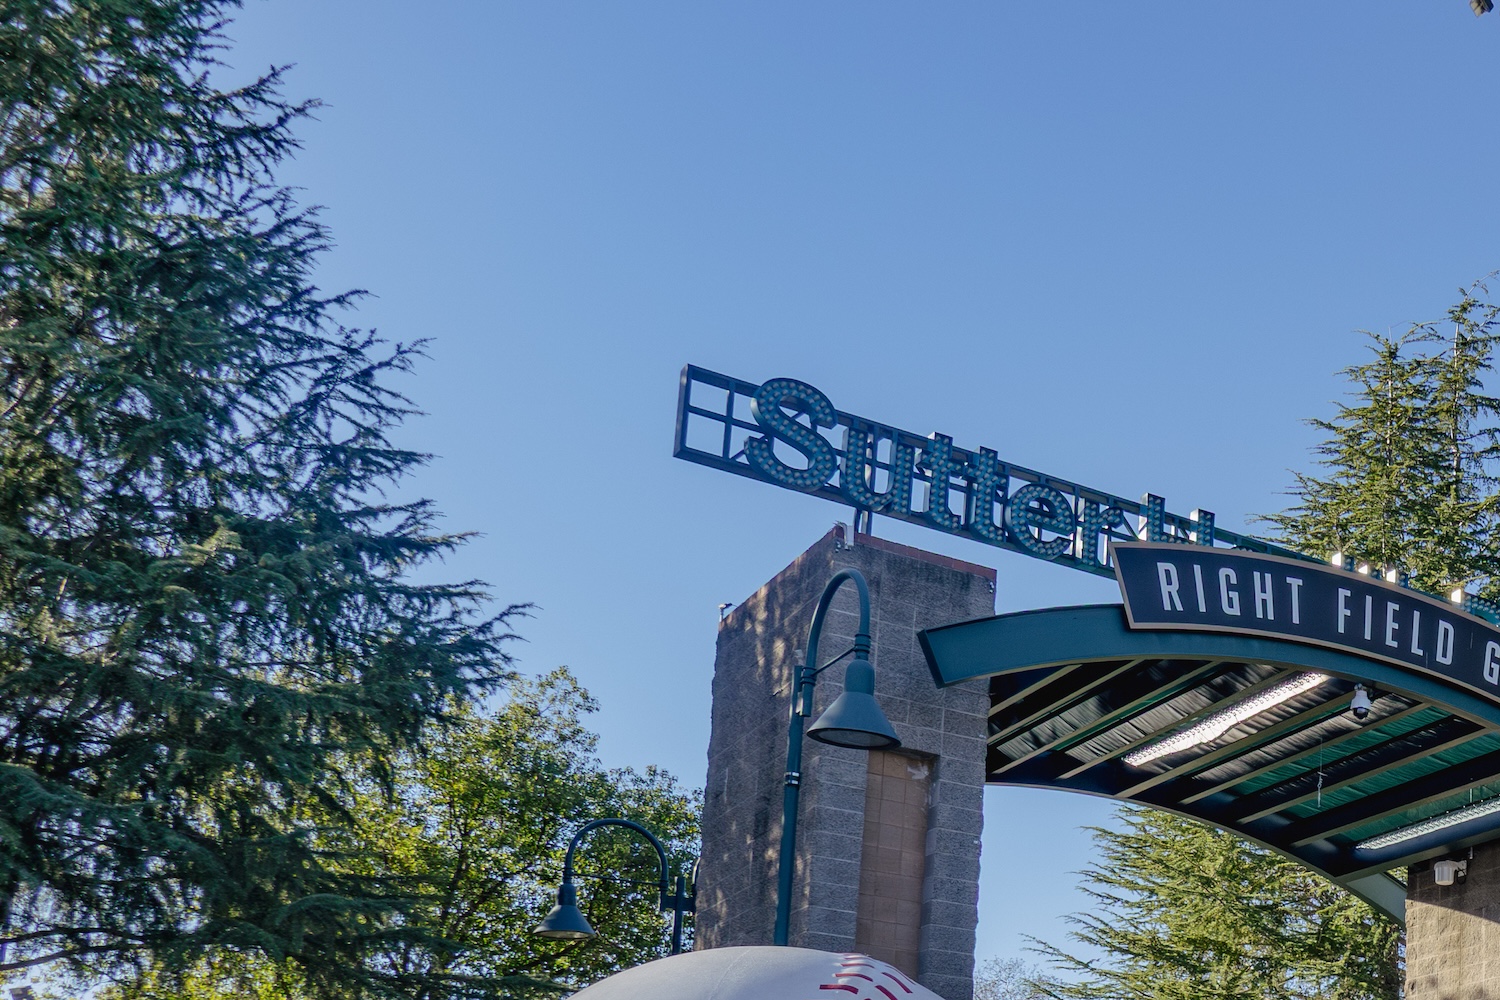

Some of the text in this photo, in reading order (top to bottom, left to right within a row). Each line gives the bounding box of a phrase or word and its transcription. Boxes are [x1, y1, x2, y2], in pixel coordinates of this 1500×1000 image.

[744, 377, 1122, 567] Sutter
[1156, 562, 1303, 624] RIGHT
[1337, 588, 1455, 666] FIELD
